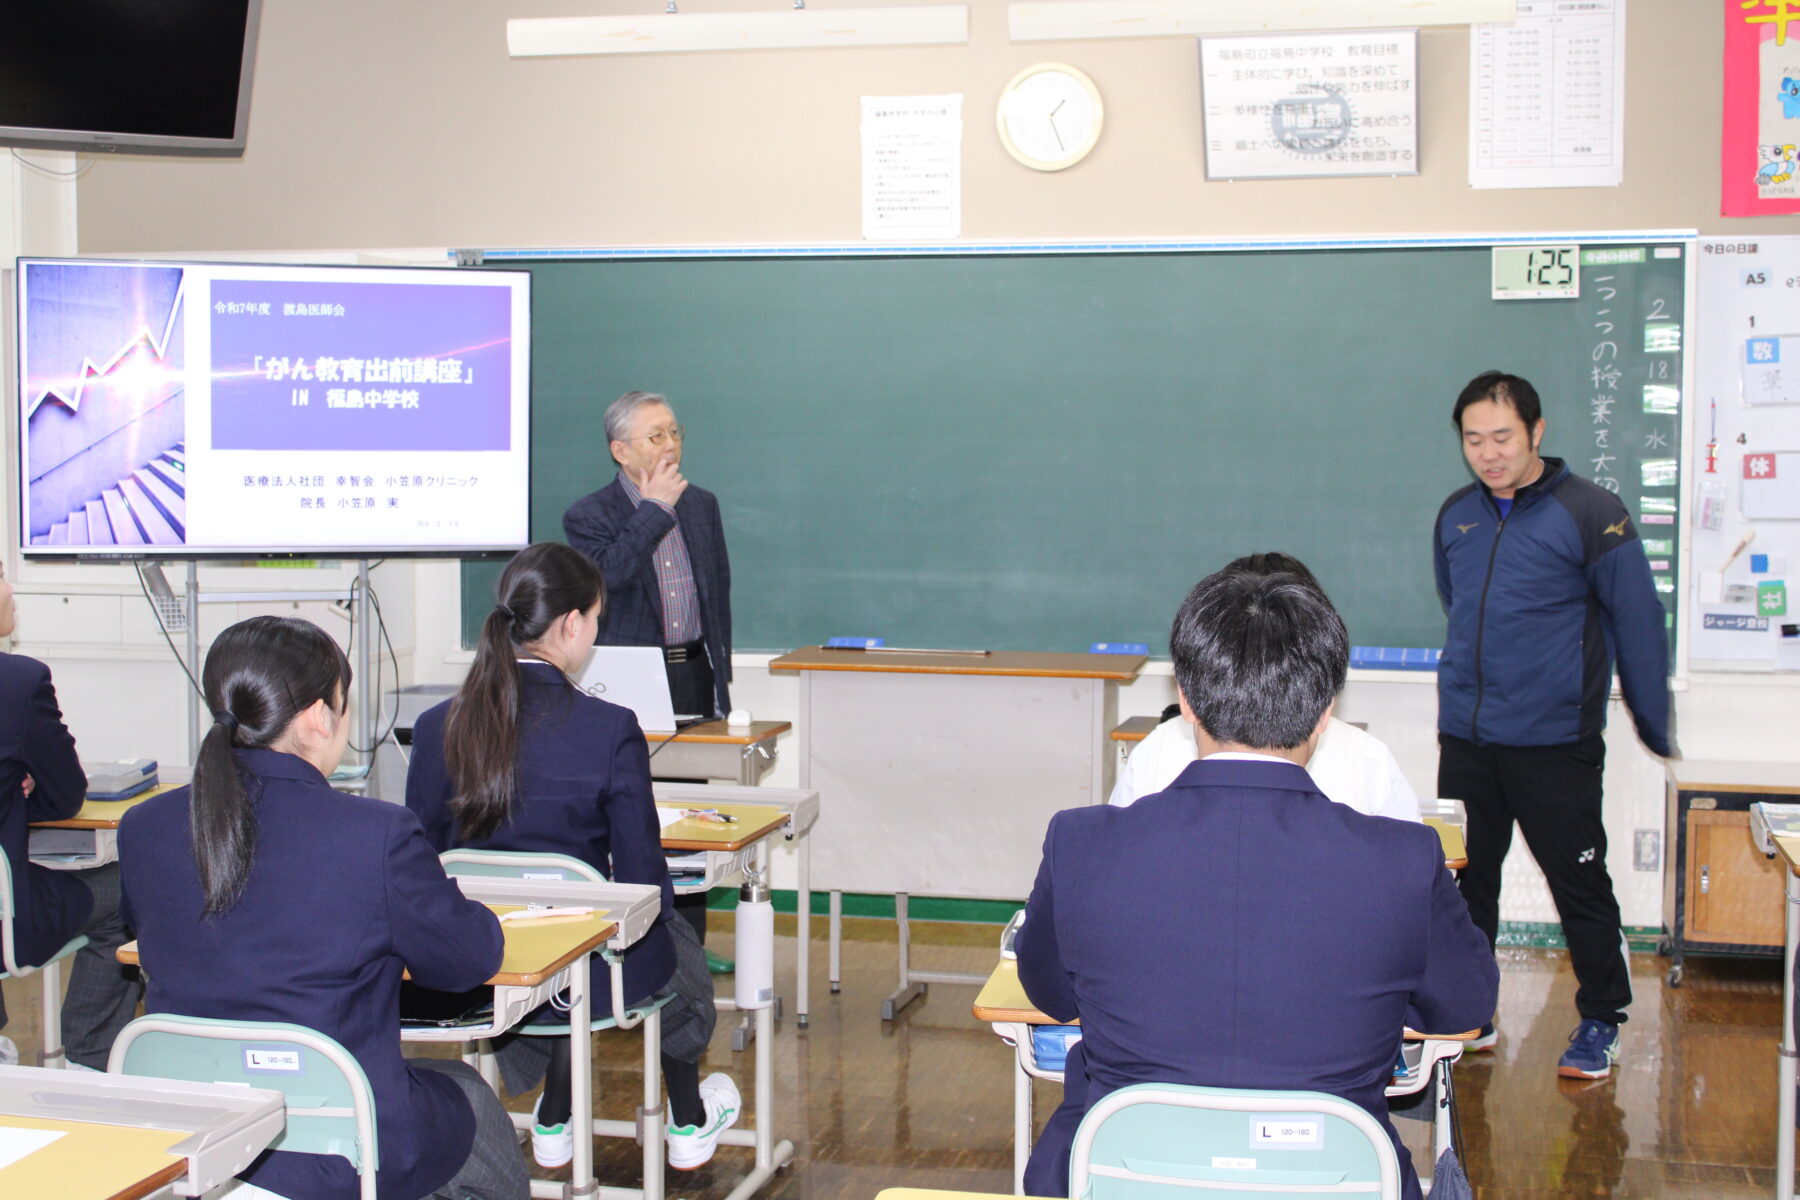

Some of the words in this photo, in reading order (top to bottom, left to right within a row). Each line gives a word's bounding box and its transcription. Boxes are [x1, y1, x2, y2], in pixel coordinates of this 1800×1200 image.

[1703, 243, 1758, 255] 今日の日課
[1745, 272, 1767, 286] A5
[213, 300, 271, 316] 令和7年度
[283, 302, 346, 317] 渡島医師会
[1645, 299, 1671, 321] 2
[1748, 315, 1756, 328] 1
[252, 356, 475, 385] 「がん教育出前講座」
[1648, 360, 1669, 380] 18
[291, 389, 309, 407] IN
[326, 389, 420, 409] 福島中学校
[1643, 427, 1668, 449] 水
[1736, 433, 1747, 445] 4
[1749, 456, 1771, 477] 体
[243, 475, 325, 488] 医療法人社団
[336, 476, 375, 488] 幸智会
[385, 476, 479, 489] 小笠原クリニック
[300, 497, 327, 509] 院長
[338, 497, 376, 510] 小笠原
[387, 497, 400, 510] 実
[252, 1053, 260, 1064] L
[1263, 1126, 1271, 1138] L
